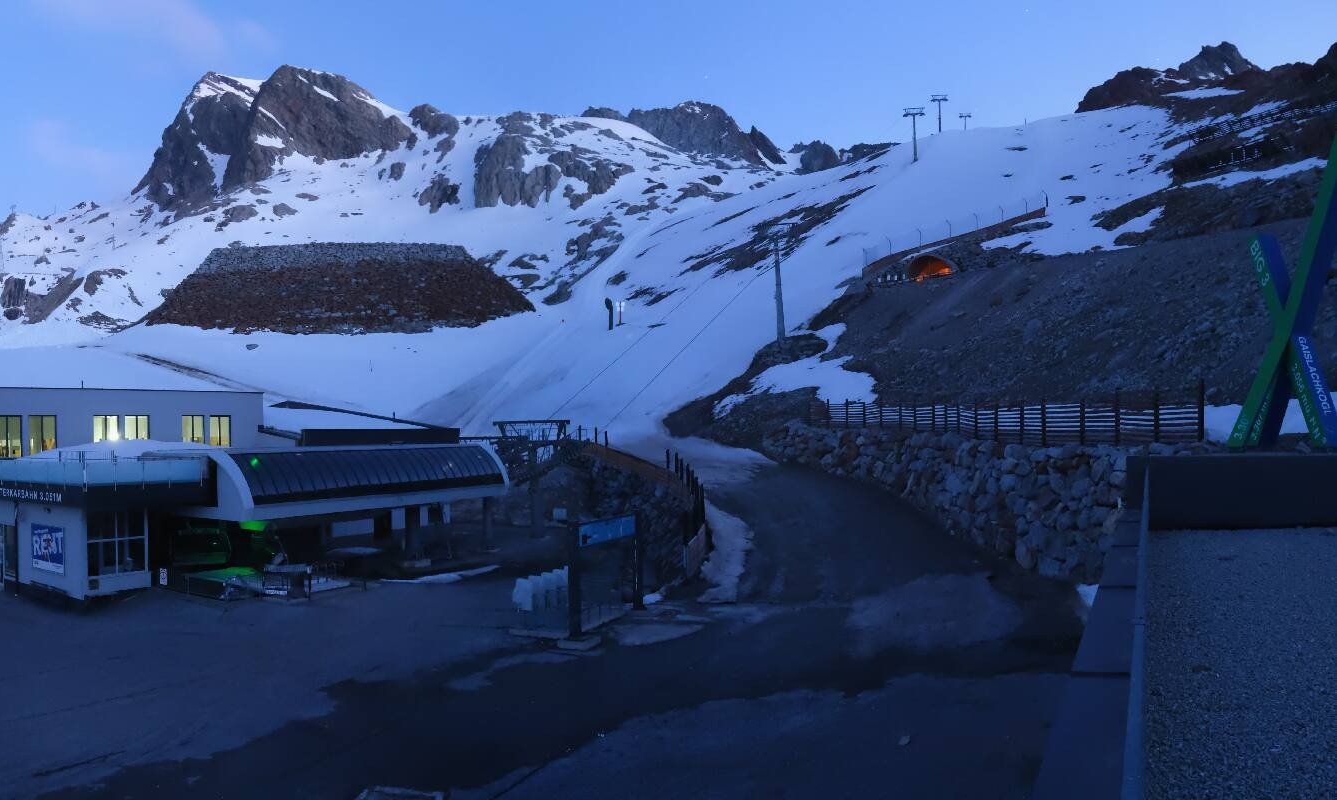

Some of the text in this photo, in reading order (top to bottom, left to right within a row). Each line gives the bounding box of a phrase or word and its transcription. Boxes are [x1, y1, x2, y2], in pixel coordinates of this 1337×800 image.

[1250, 240, 1270, 287] BIG 3
[1298, 336, 1332, 416] GAISLACHKOGL
